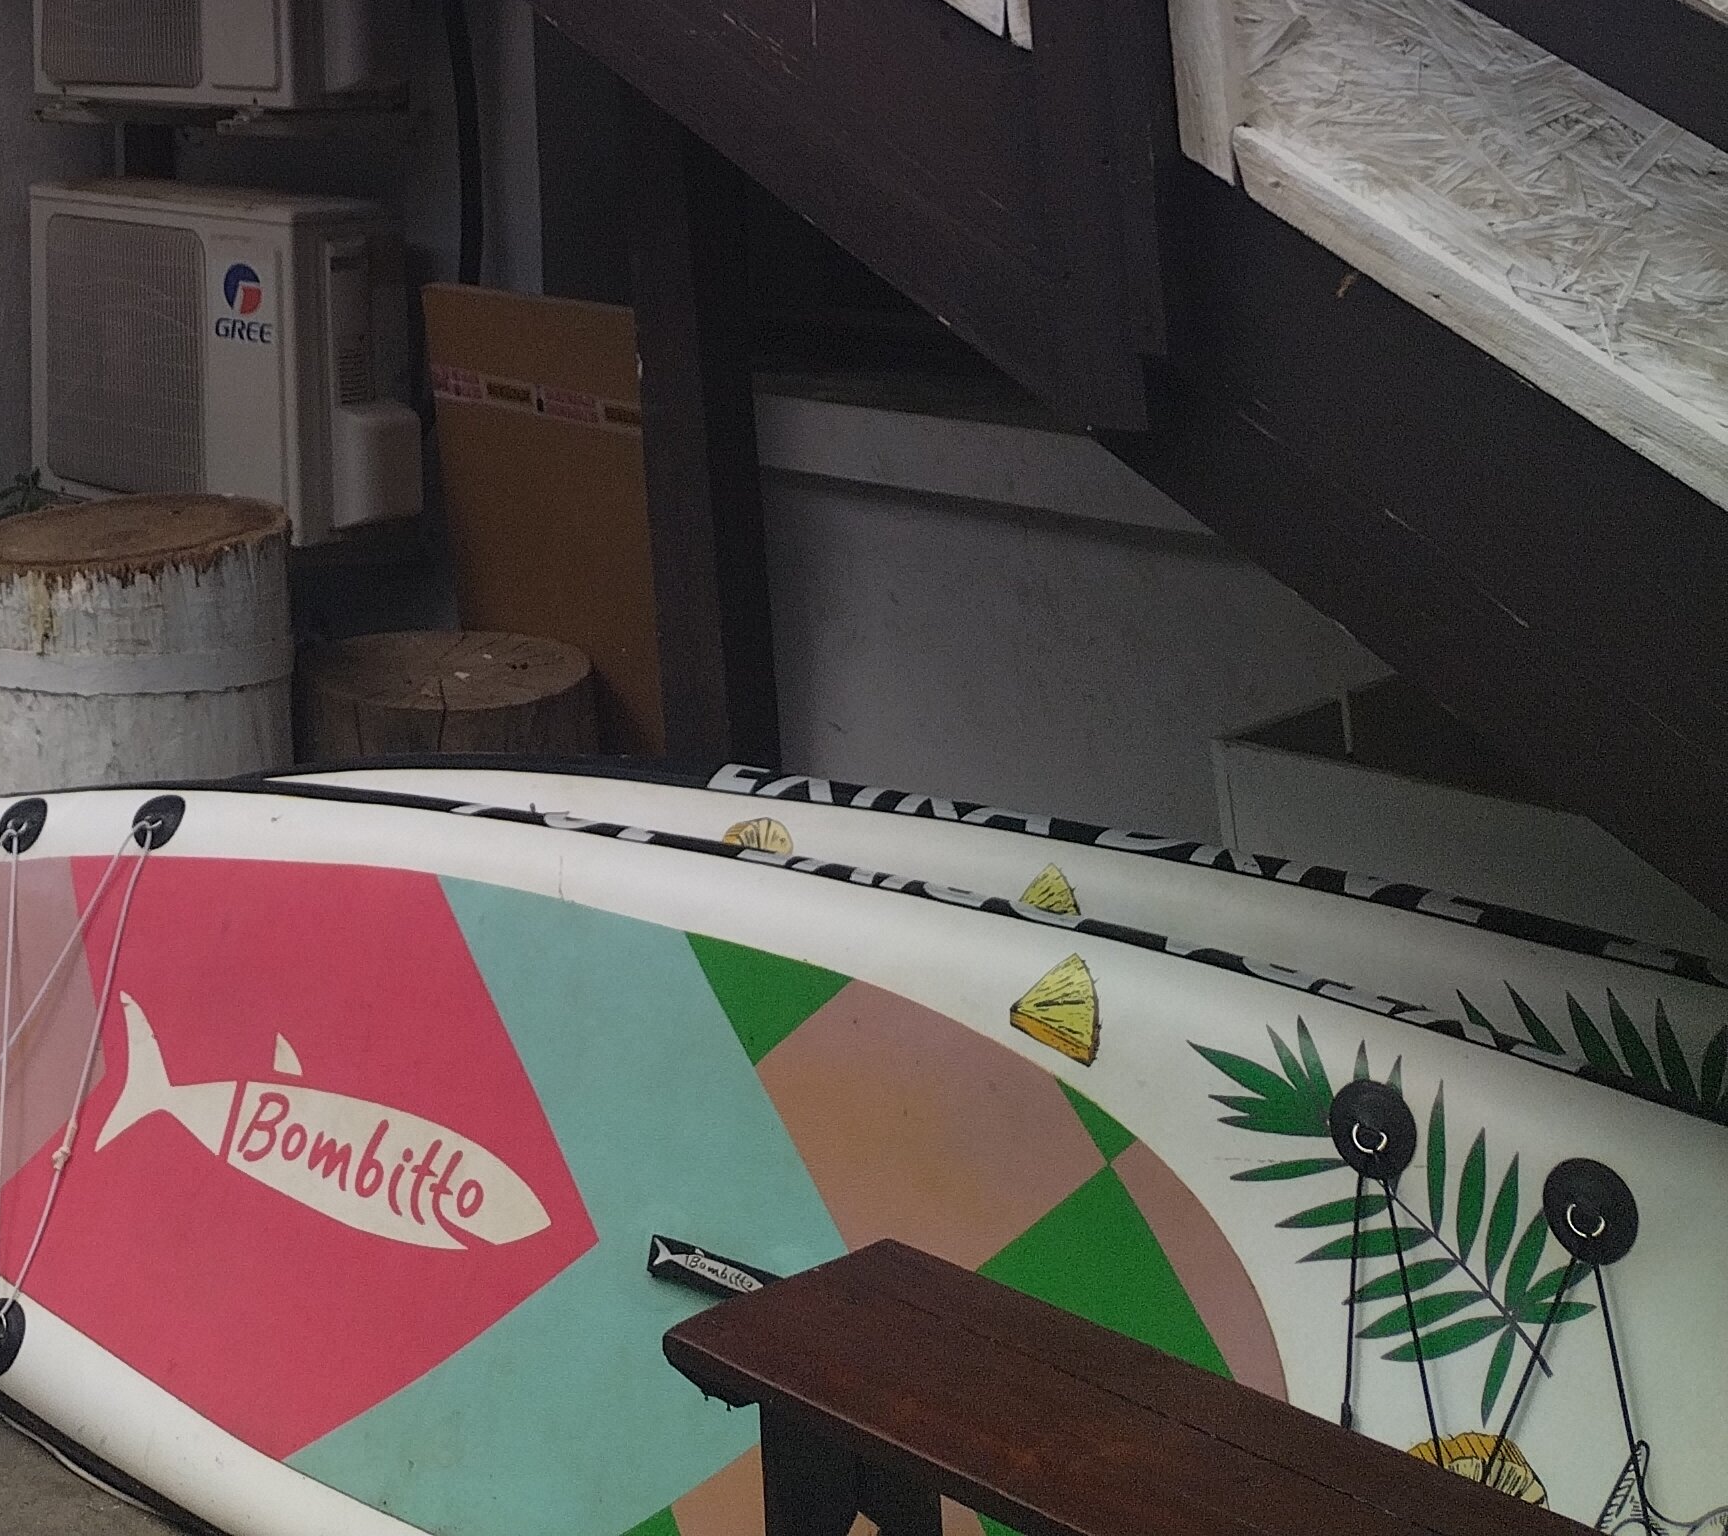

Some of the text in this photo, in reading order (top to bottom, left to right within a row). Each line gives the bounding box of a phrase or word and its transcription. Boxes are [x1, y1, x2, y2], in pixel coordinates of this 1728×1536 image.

[215, 317, 272, 344] GREE
[237, 1091, 484, 1233] Bombitto
[688, 1256, 753, 1291] Bombitto
